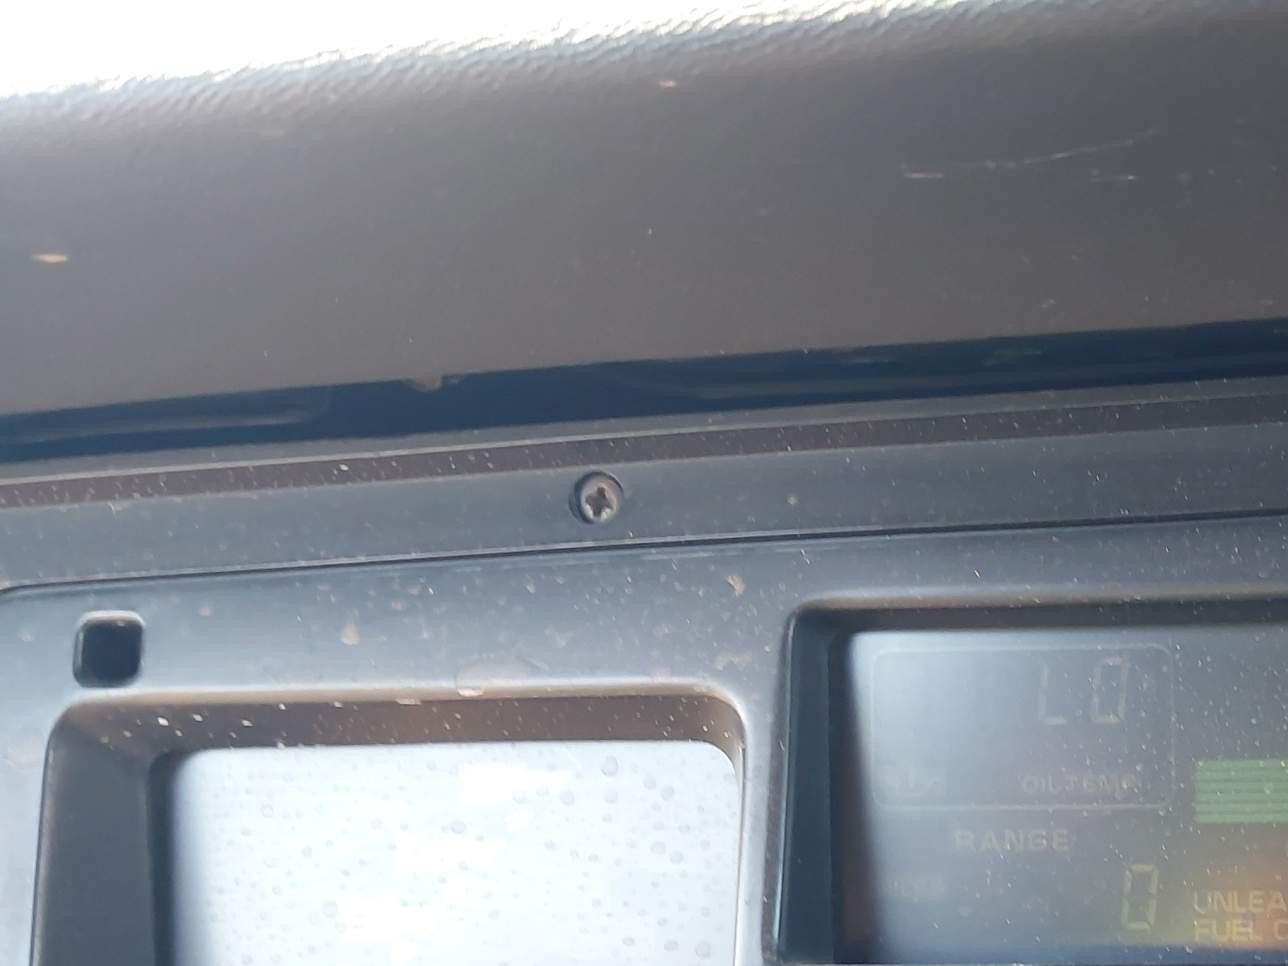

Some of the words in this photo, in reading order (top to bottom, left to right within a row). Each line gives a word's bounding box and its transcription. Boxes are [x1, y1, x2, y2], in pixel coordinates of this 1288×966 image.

[1022, 775, 1061, 794] OIL
[953, 829, 1071, 852] RANGE
[1122, 864, 1158, 930] 0
[1194, 918, 1264, 942] FUEL
